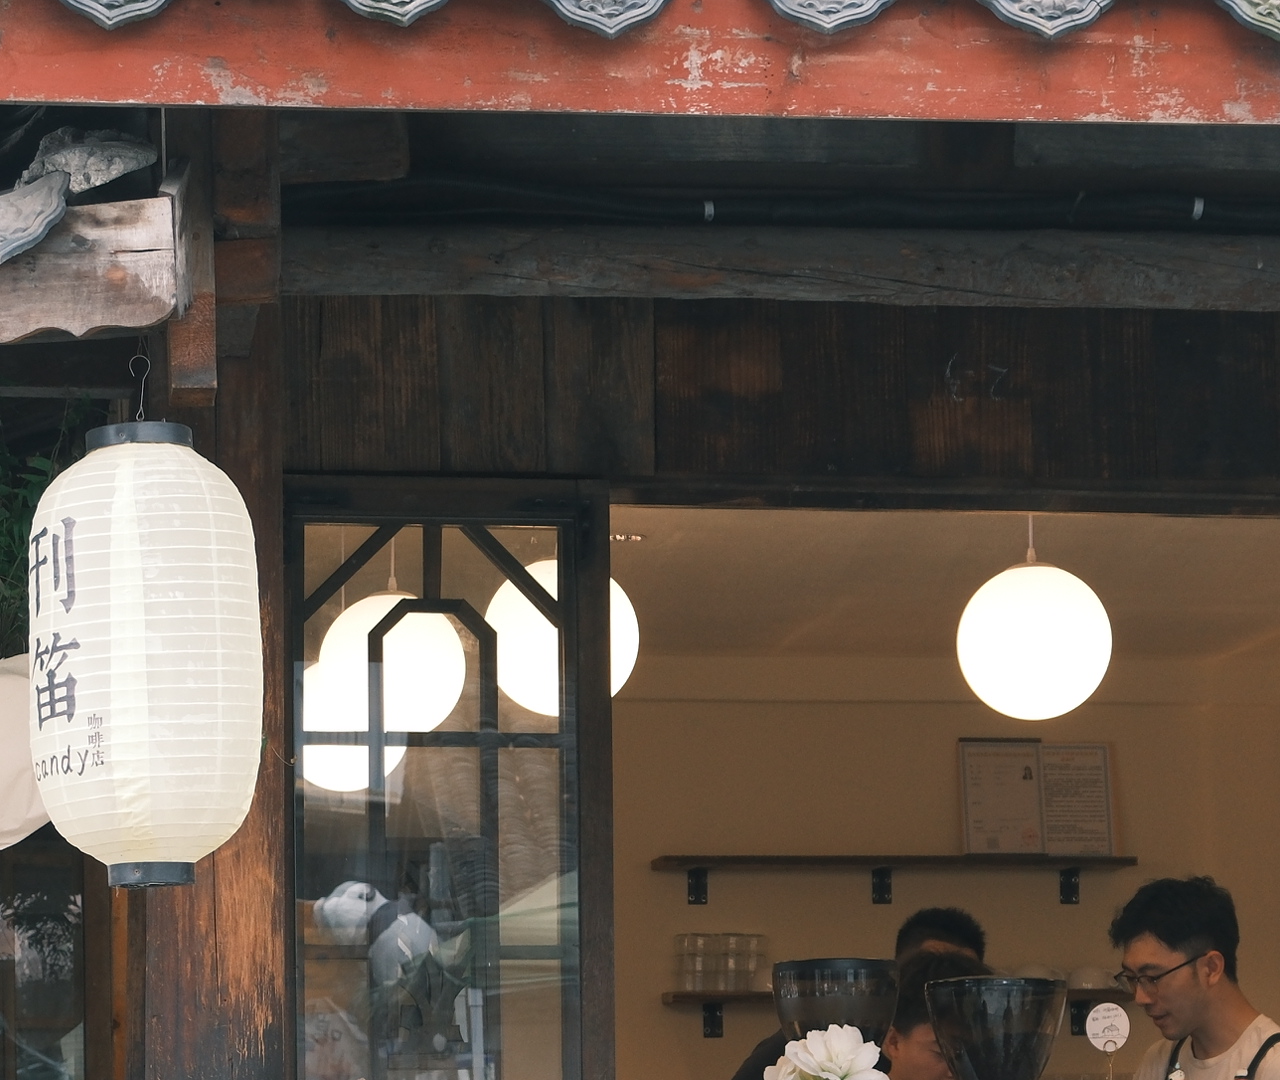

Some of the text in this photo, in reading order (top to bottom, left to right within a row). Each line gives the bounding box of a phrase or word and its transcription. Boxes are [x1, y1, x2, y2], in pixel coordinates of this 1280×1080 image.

[30, 516, 81, 731] 刊笛
[35, 745, 89, 781] candy
[87, 713, 104, 767] 咖啡店
